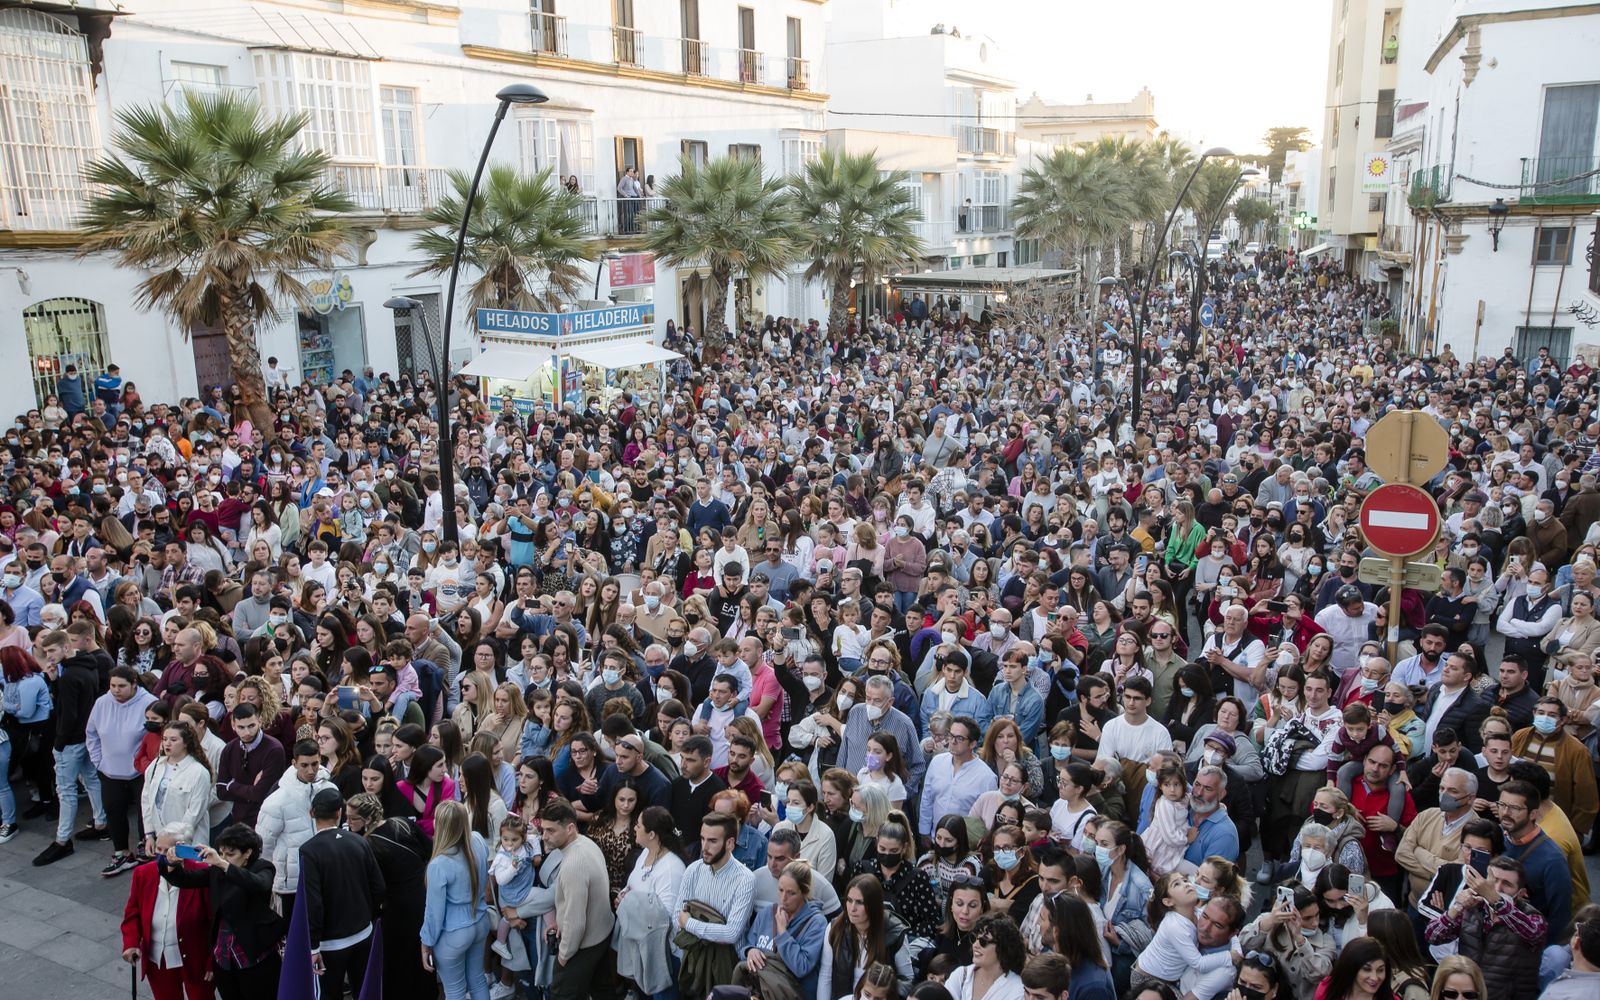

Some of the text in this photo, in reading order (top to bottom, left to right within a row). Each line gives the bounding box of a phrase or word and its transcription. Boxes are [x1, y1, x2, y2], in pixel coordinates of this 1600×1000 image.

[307, 280, 332, 295] TOY
[486, 312, 550, 331] HELADOS
[575, 308, 639, 331] HELADERIA
